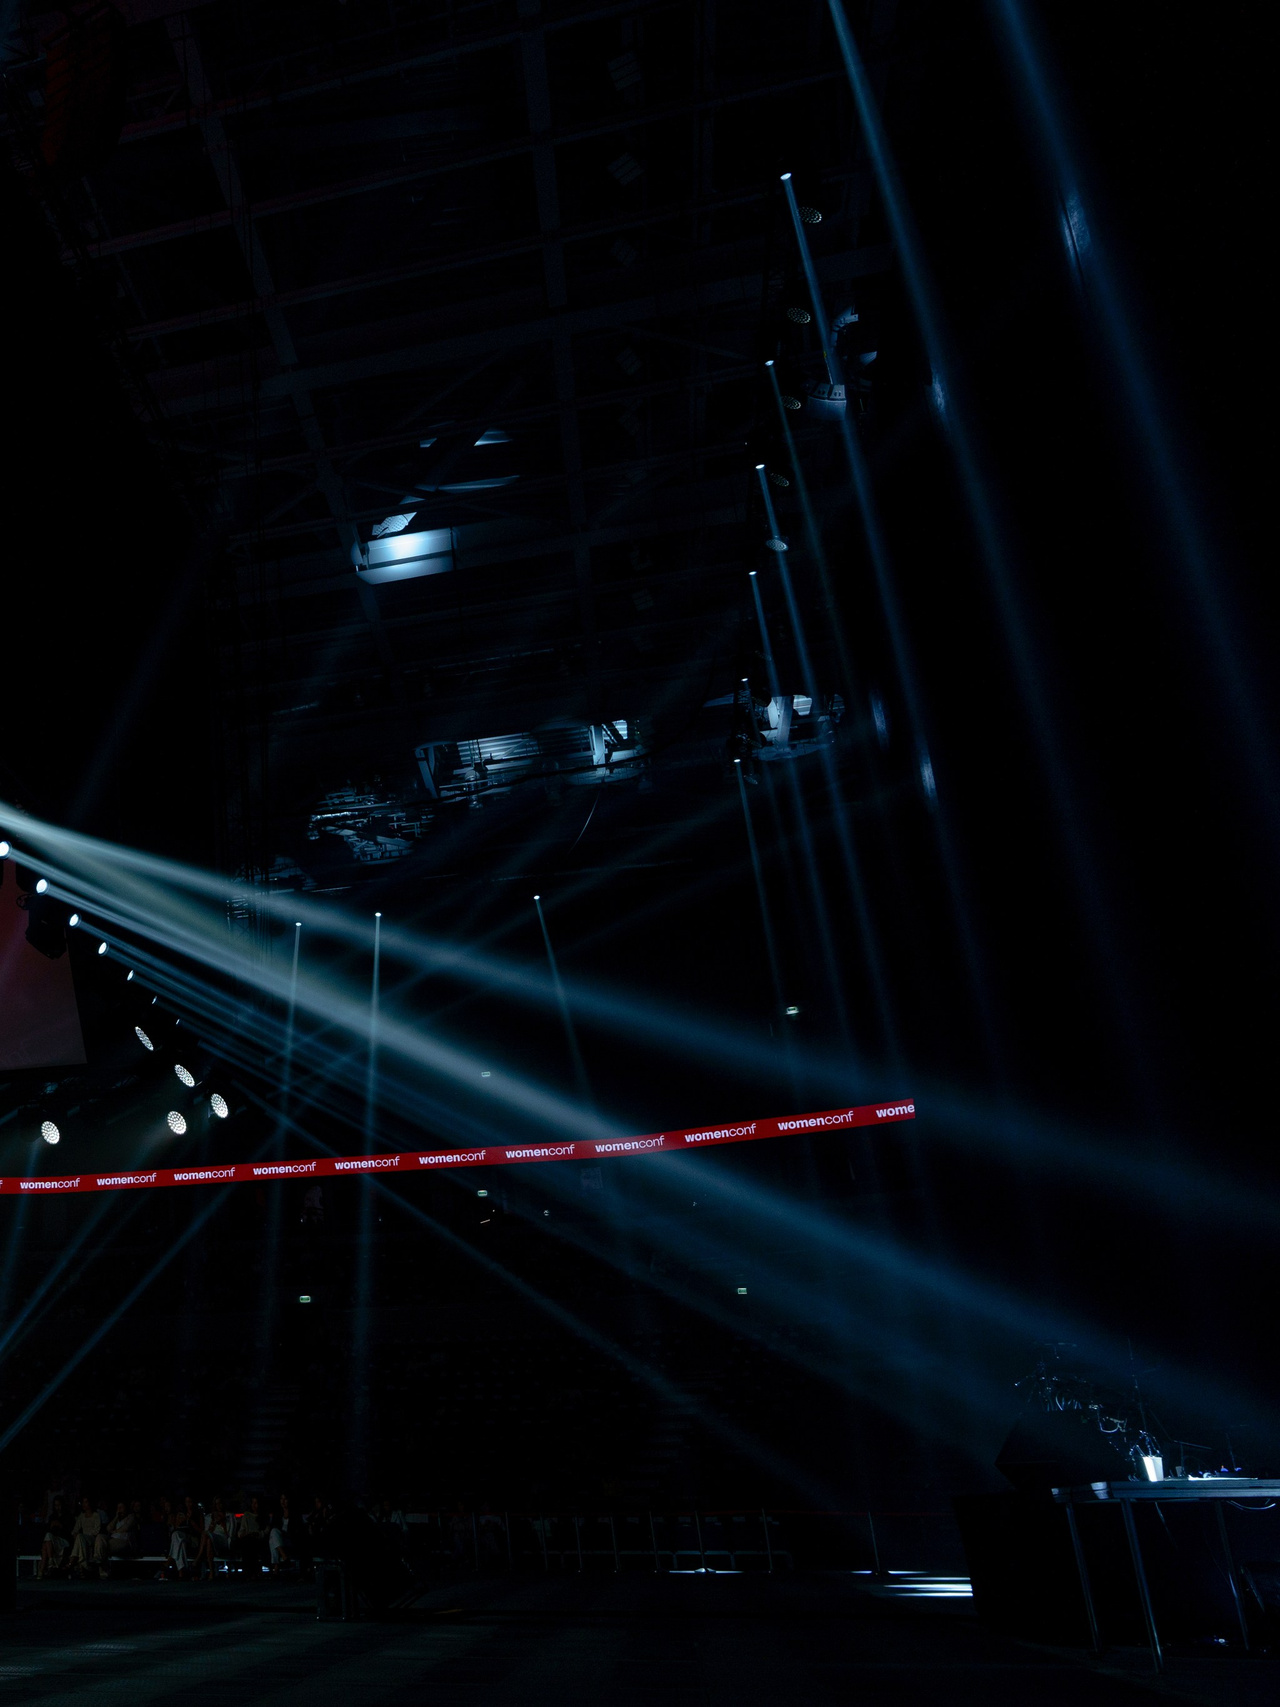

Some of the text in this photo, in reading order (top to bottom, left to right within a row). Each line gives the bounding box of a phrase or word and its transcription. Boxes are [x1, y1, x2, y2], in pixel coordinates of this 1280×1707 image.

[20, 1178, 81, 1190] womenconf
[96, 1172, 157, 1187] womenconf
[173, 1167, 236, 1181] womenconf
[253, 1161, 317, 1175] womenconf
[334, 1156, 401, 1170] womenconf
[418, 1150, 486, 1165] womenconf
[505, 1144, 575, 1159] womenconf
[595, 1135, 665, 1153] womenconf
[684, 1123, 757, 1143] womenconf
[777, 1111, 854, 1131] womenconf
